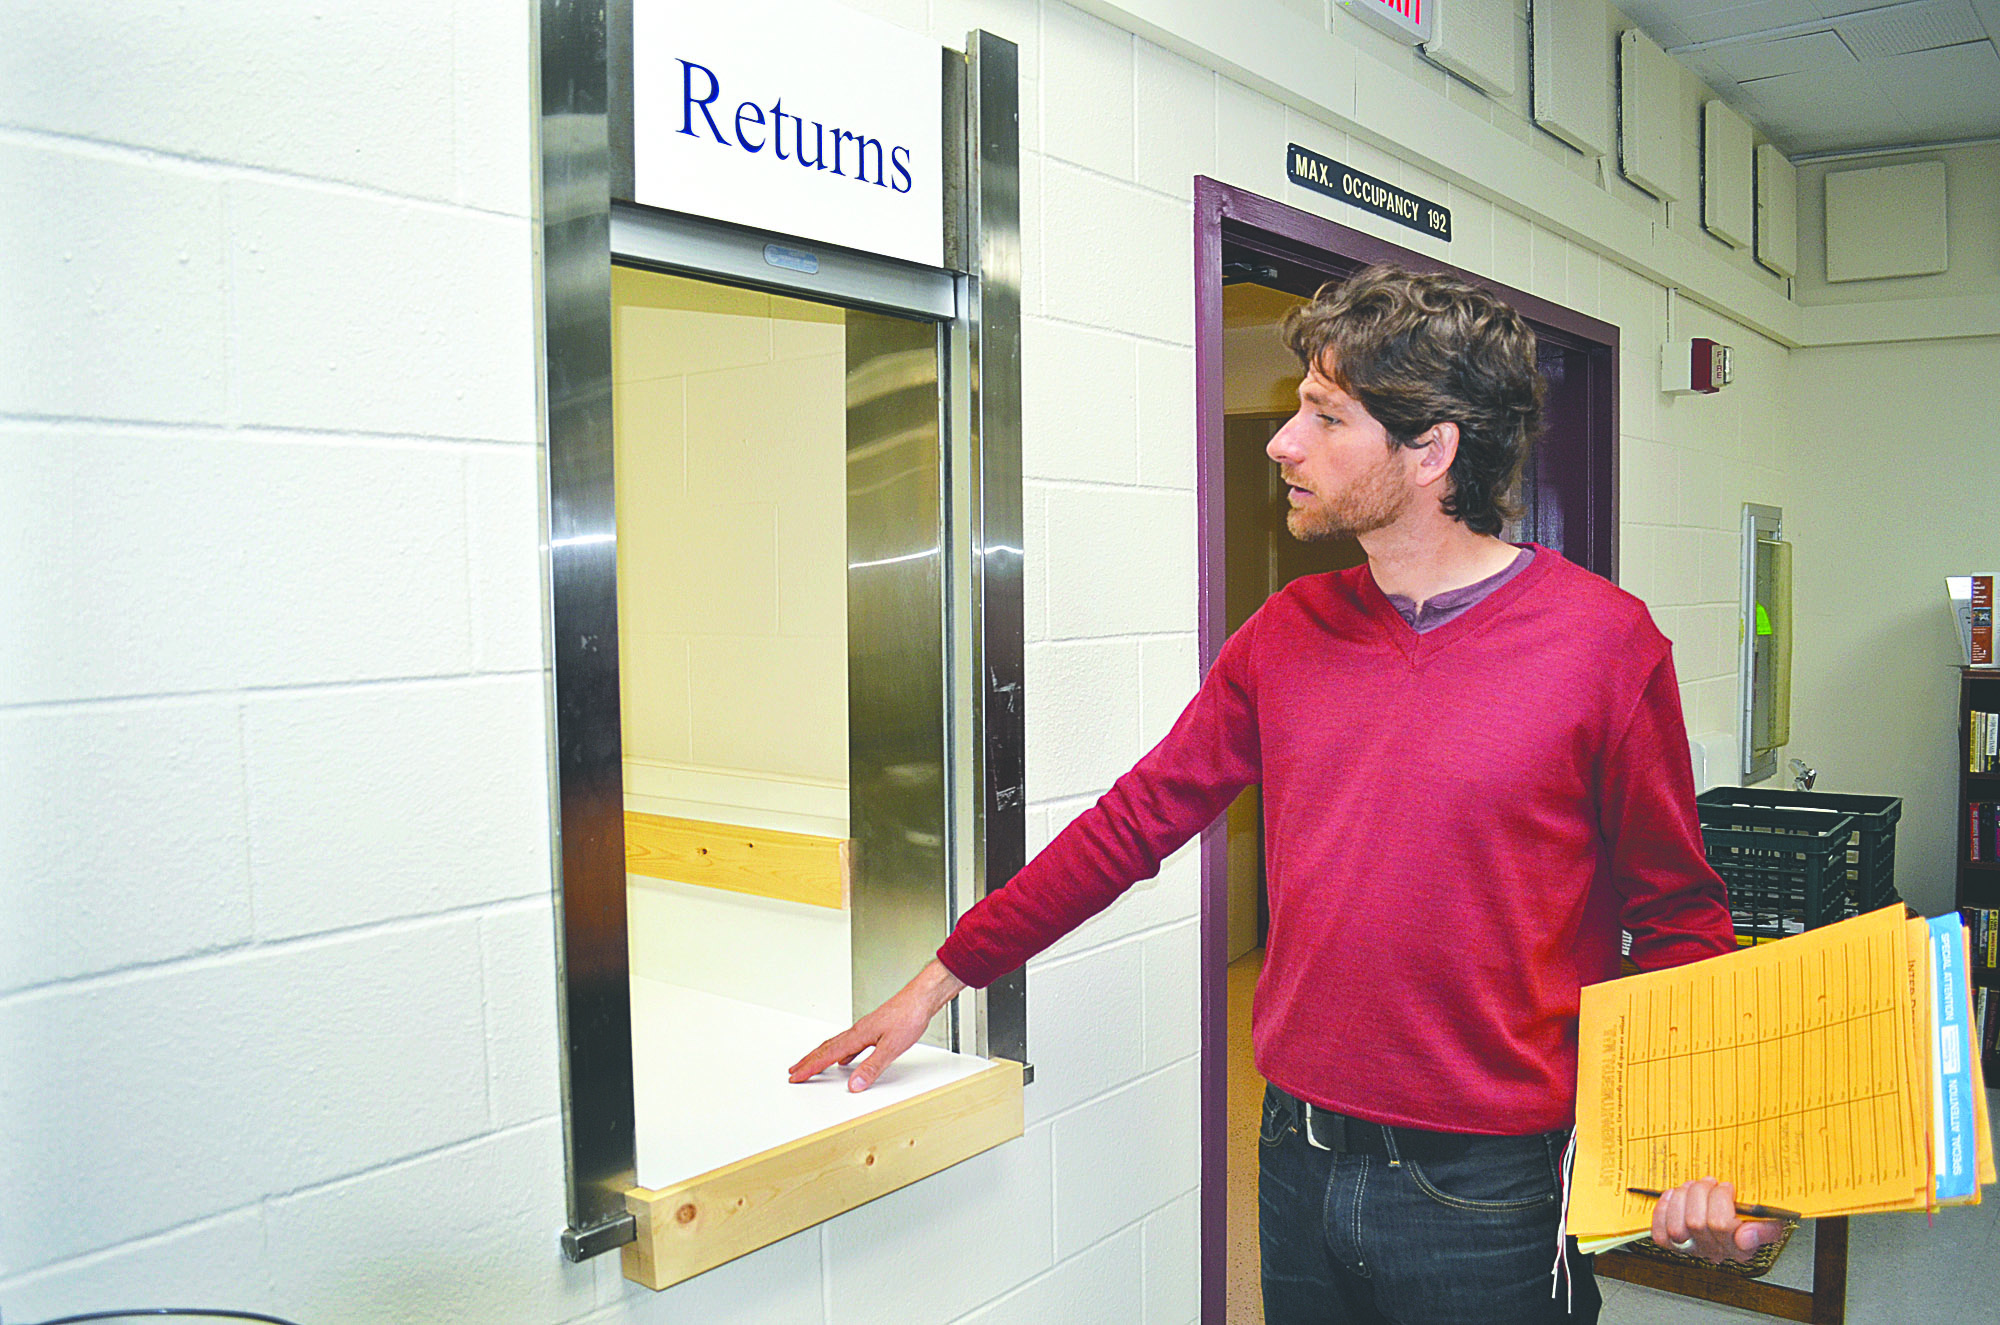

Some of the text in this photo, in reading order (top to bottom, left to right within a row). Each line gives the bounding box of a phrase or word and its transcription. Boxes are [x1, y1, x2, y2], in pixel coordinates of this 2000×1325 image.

[674, 58, 912, 193] Returns
[1295, 153, 1448, 233] MAX. OCCUPANCY 192
[1941, 932, 1952, 970] SPECIAL
[1944, 972, 1955, 1021] ATTENTION
[1949, 1079, 1960, 1132] ATTENTION
[1952, 1133, 1962, 1176] SPECIAL
